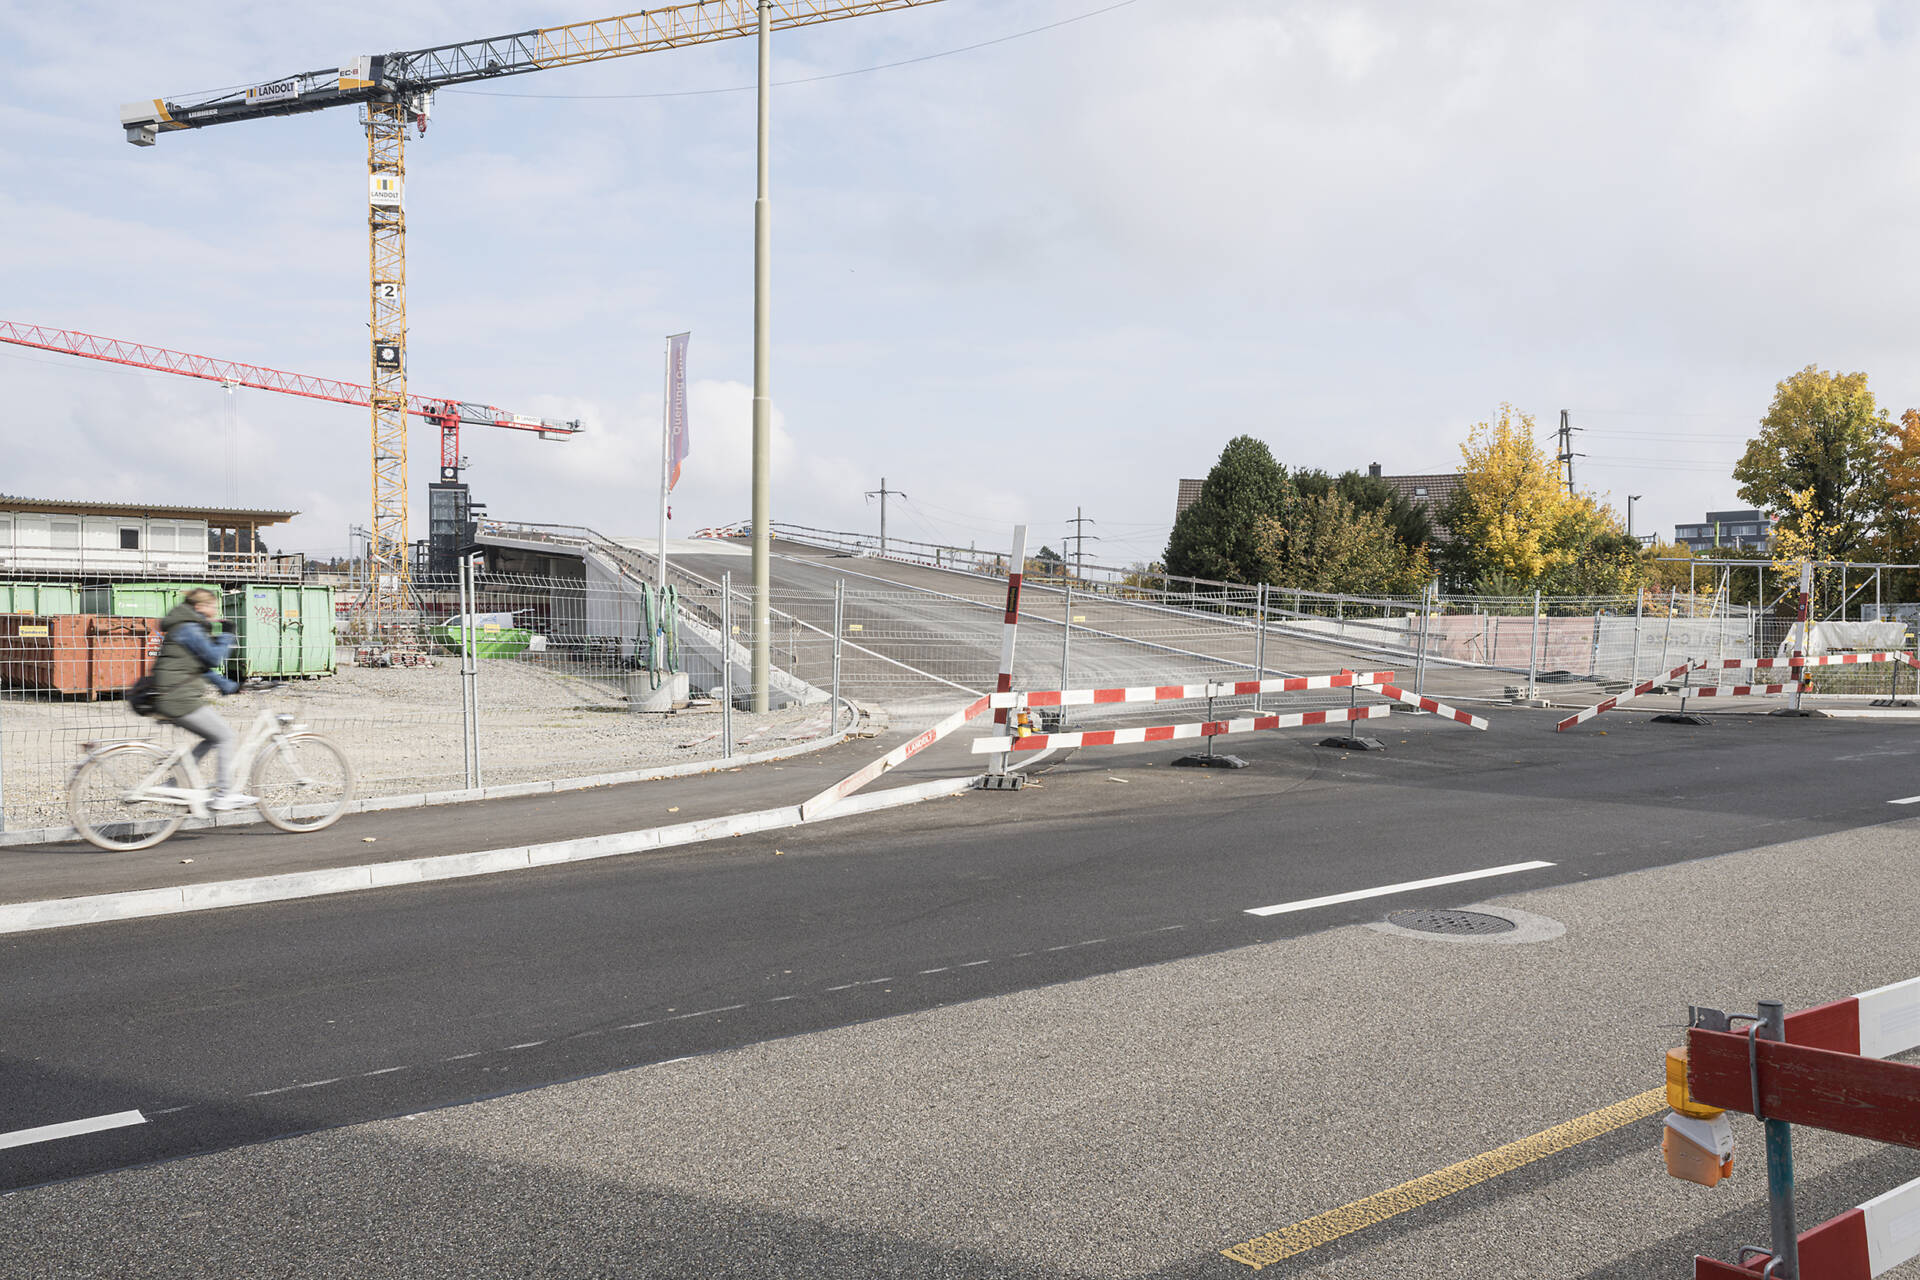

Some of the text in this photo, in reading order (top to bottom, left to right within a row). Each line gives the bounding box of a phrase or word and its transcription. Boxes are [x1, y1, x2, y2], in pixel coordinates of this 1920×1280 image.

[258, 82, 294, 96] LANDOLT
[371, 190, 399, 199] LANDOLT
[384, 285, 395, 297] 2
[673, 382, 684, 435] Querung
[906, 733, 934, 754] LANDOLT
